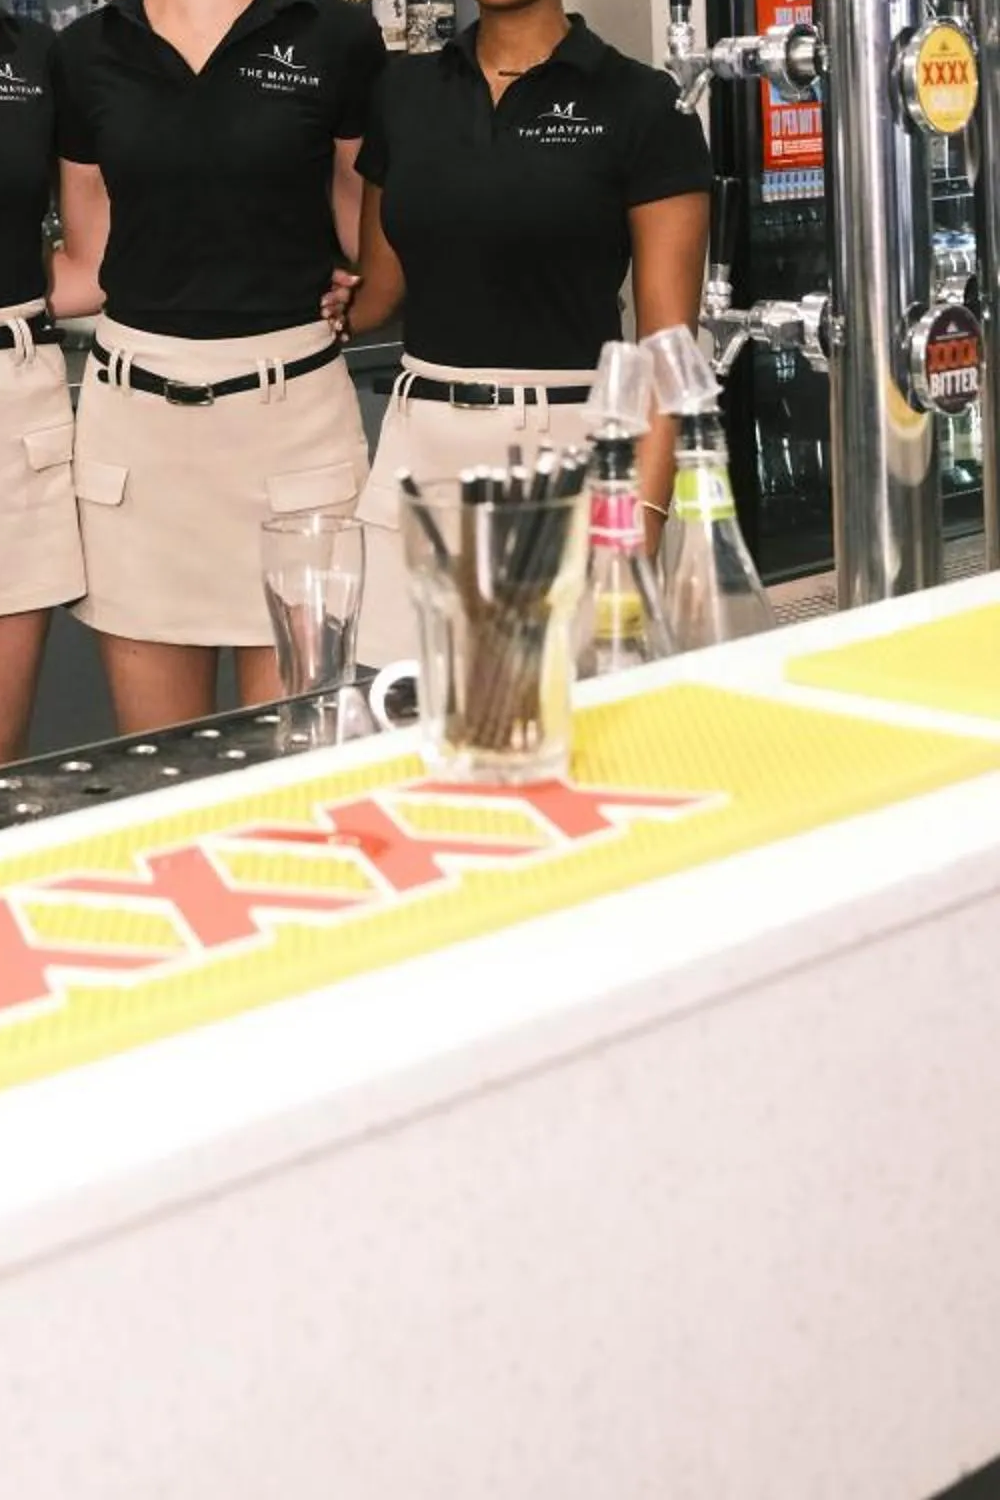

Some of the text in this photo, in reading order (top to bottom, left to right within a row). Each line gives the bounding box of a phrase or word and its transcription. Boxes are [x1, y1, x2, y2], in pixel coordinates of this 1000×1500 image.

[239, 67, 263, 79] THE
[267, 70, 320, 87] MAYFAIR
[922, 60, 970, 87] XXXX
[519, 124, 604, 138] THE MAYFAIR
[930, 366, 981, 398] BITTER
